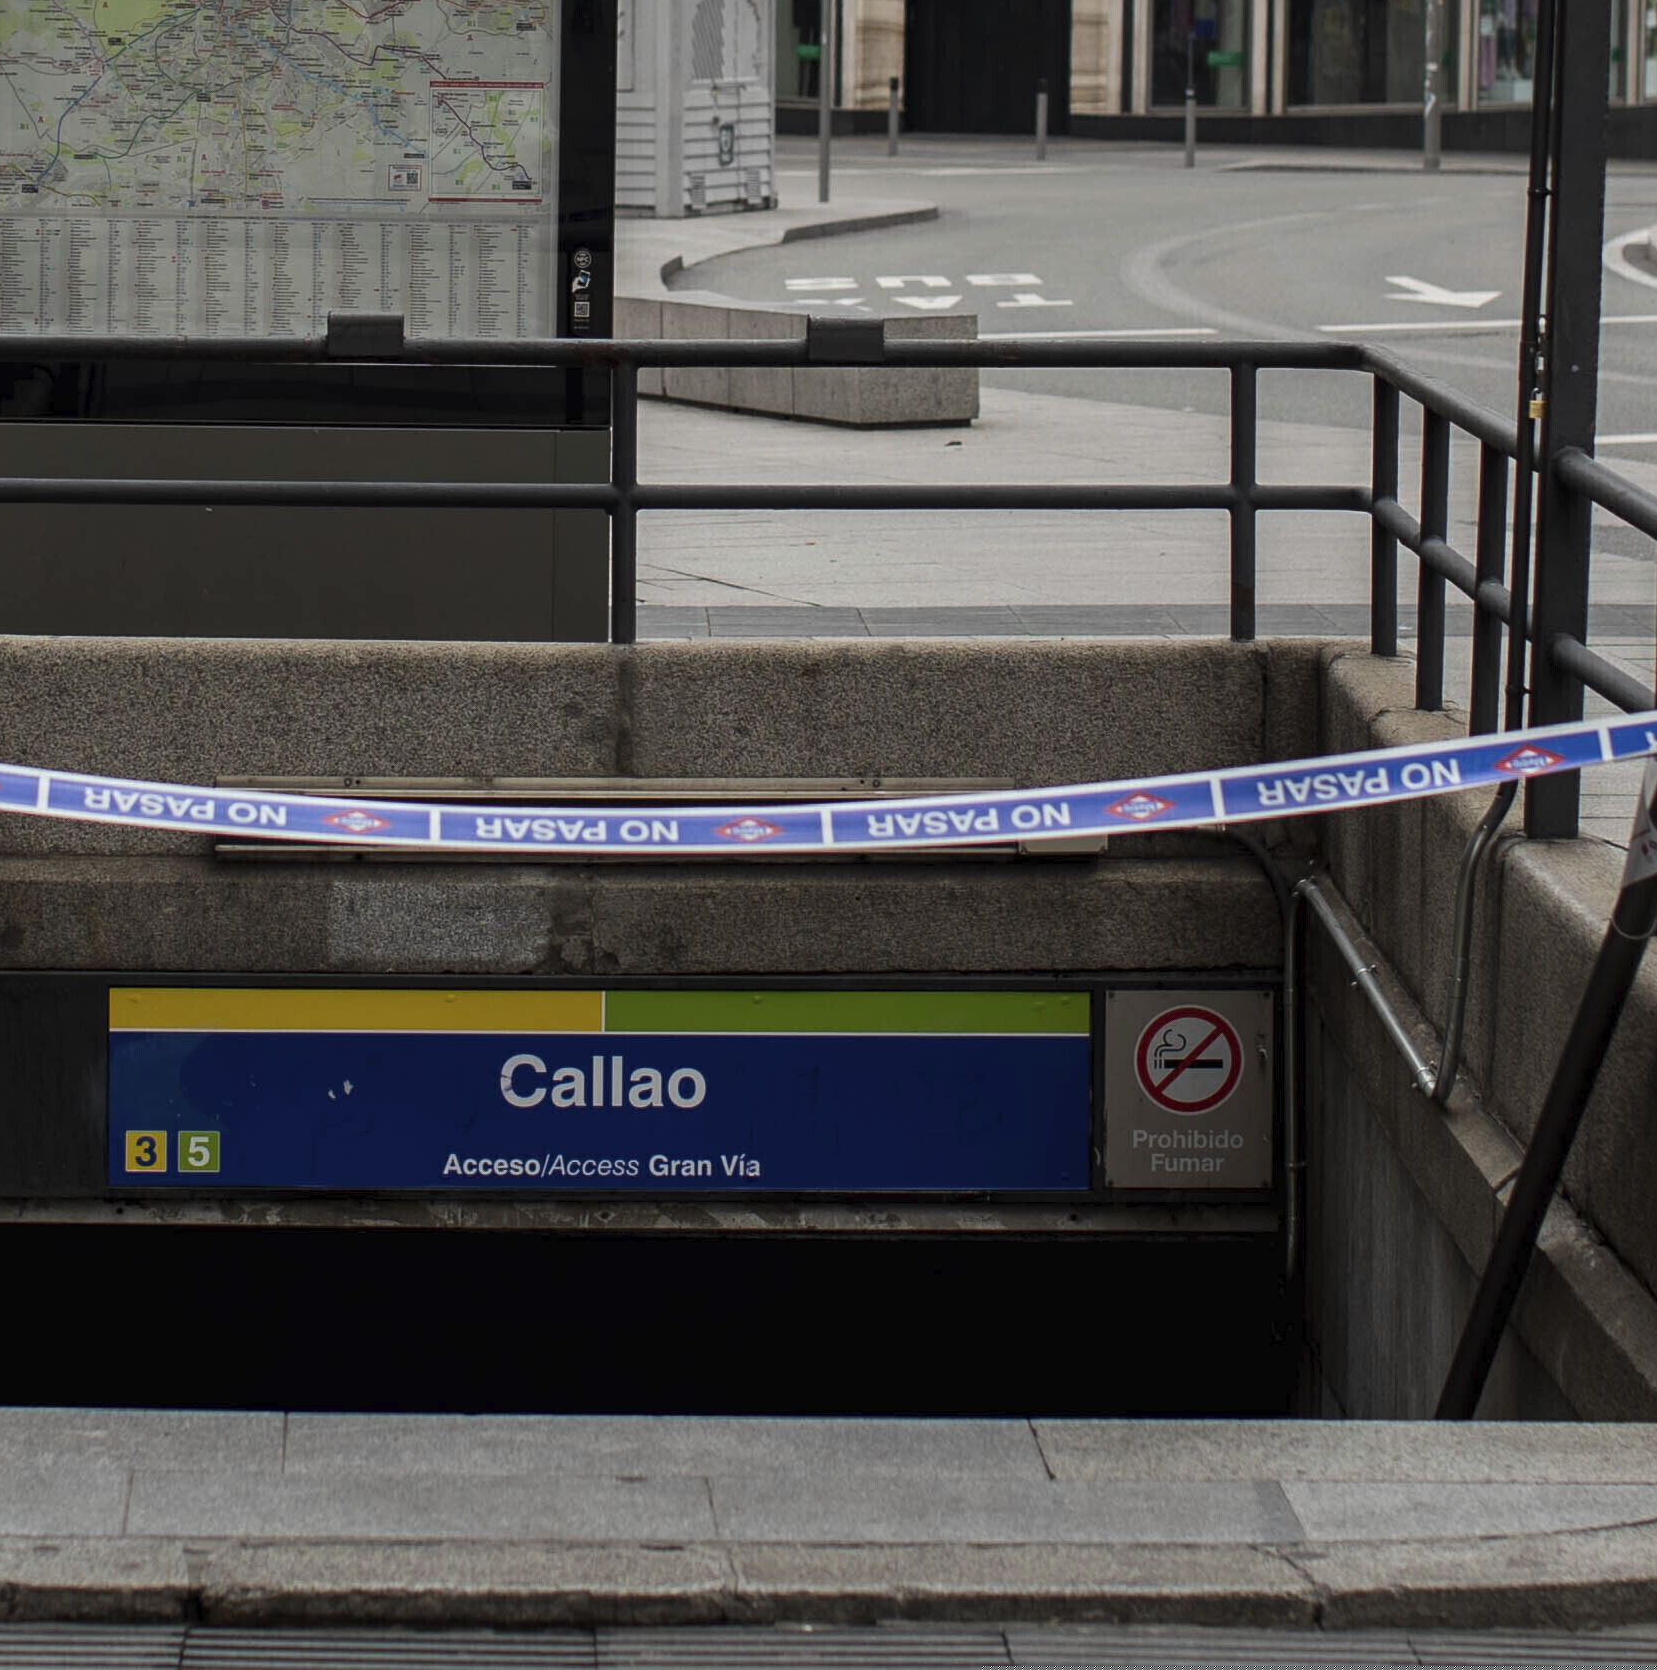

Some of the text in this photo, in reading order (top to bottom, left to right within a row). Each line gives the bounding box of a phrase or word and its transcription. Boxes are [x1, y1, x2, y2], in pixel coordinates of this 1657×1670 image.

[1256, 758, 1462, 807] NO PASAR
[83, 786, 287, 827] NO PASAR
[867, 802, 1072, 838] NO PASAR
[475, 816, 680, 843] NO PASAR
[499, 1053, 707, 1108] Callao
[134, 1135, 211, 1168] 3 5
[1132, 1129, 1244, 1149] Prohibido
[442, 1153, 762, 1178] Acceso/Access Gran Vía
[1149, 1152, 1226, 1173] Fumar
